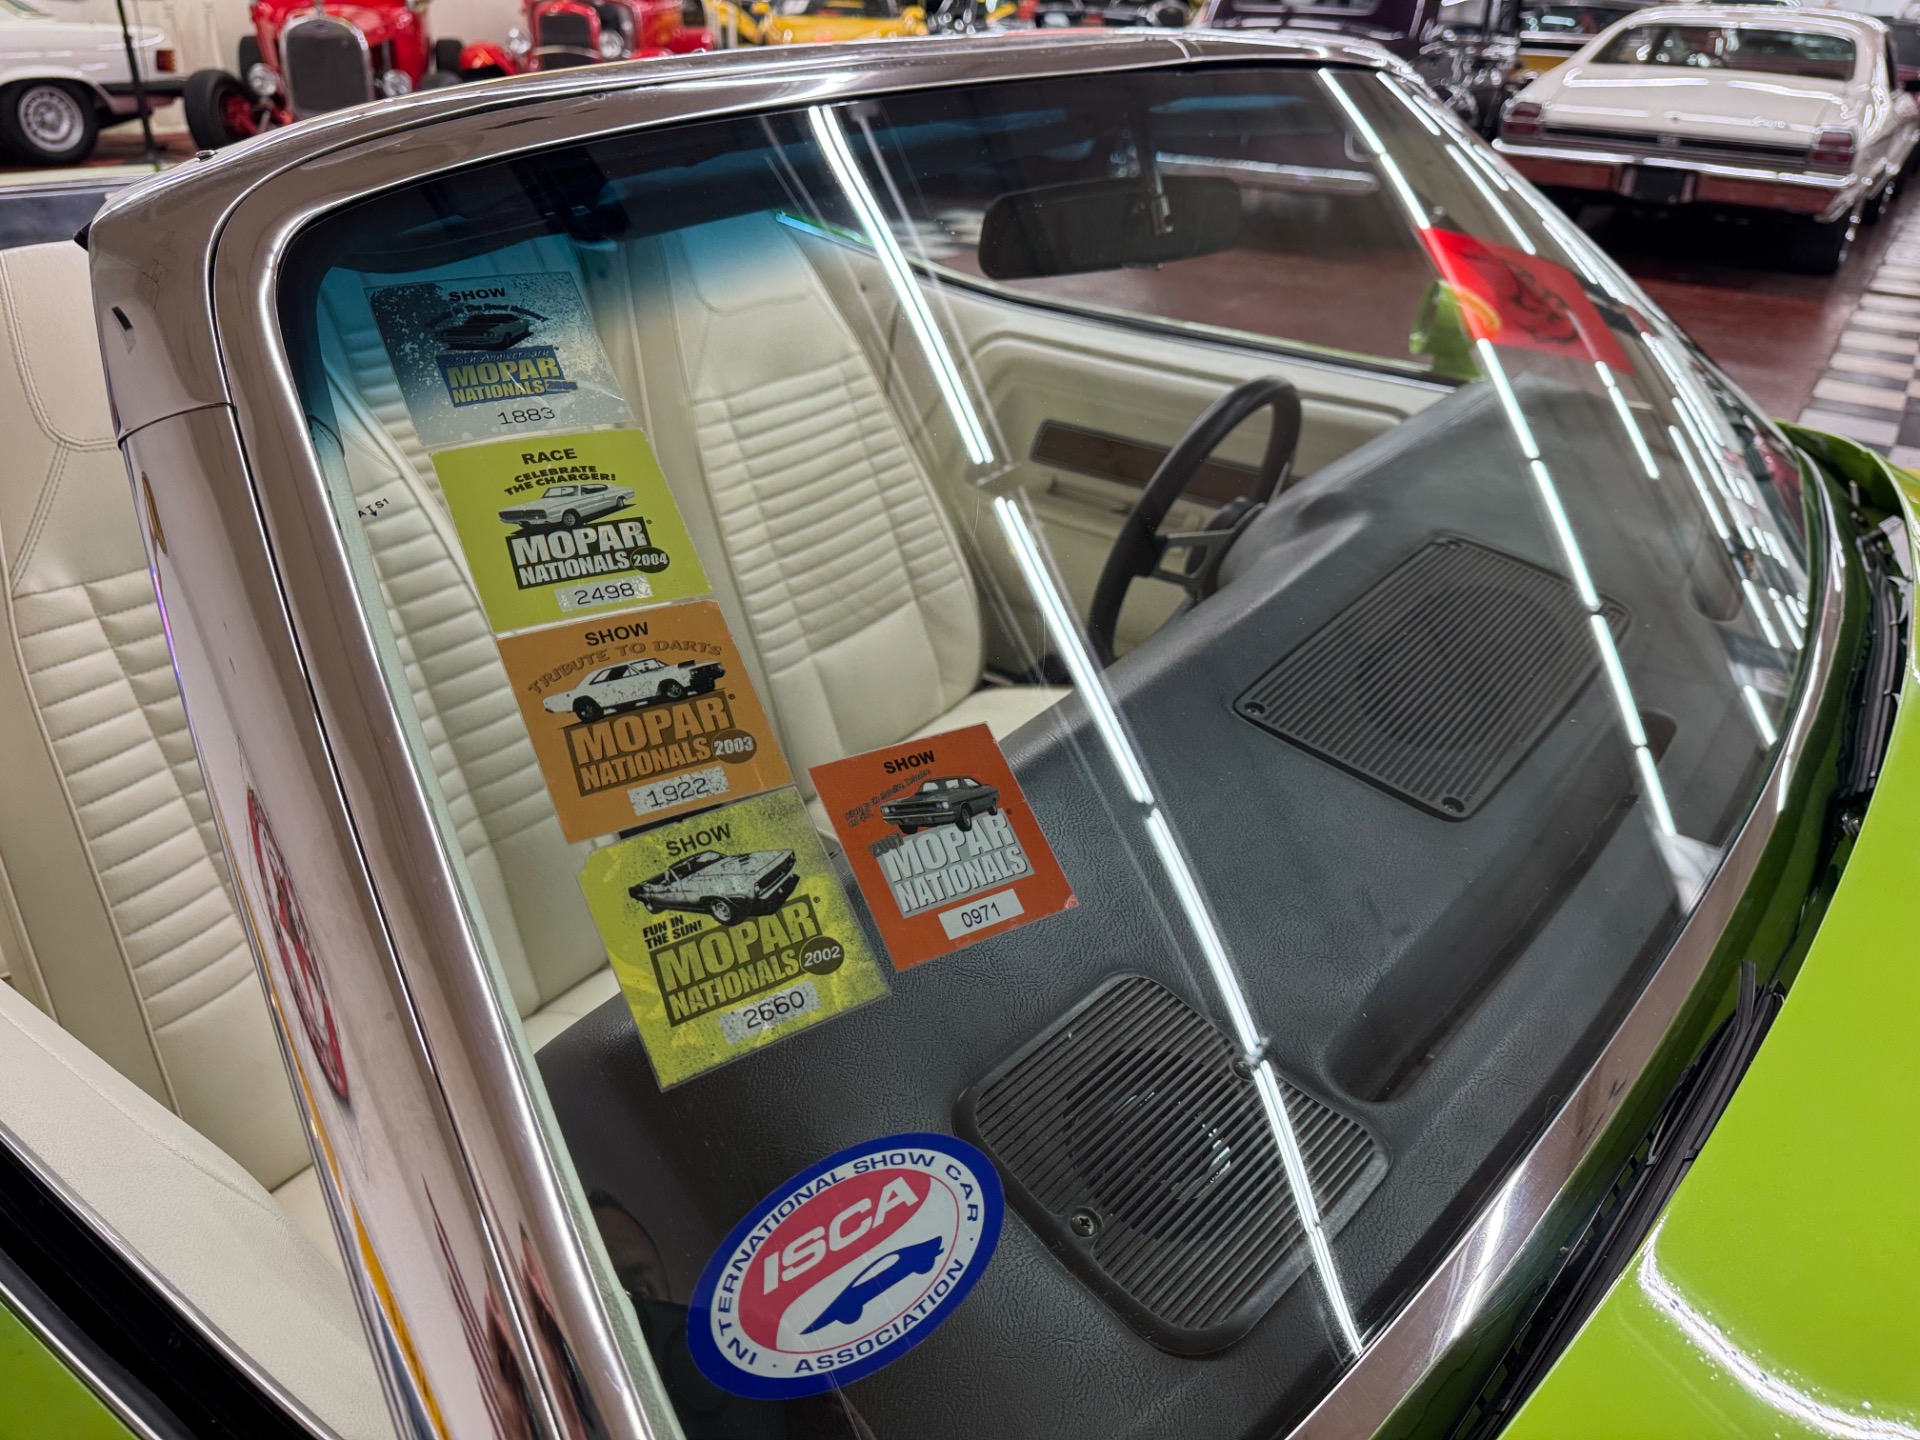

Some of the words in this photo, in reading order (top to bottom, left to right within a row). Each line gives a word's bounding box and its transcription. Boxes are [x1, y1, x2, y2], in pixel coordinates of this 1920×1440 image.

[448, 288, 506, 301] SHOW
[480, 350, 550, 363] Anniversary
[446, 357, 560, 389] MOPAR
[453, 380, 546, 404] NATIONALS
[497, 407, 556, 425] 1883
[521, 448, 578, 465] RACE
[504, 481, 533, 496] THE
[535, 473, 616, 487] CHARGER!
[513, 465, 597, 483] CELEBRATE
[511, 520, 648, 566] MOPAR
[518, 551, 630, 586] NATIONALS
[633, 553, 668, 567] 2004
[574, 582, 635, 605] 2498
[584, 621, 649, 646] SHOW
[527, 649, 611, 695] TRIBUTE
[614, 642, 647, 657] TO
[653, 640, 723, 657] DARTS
[571, 697, 731, 765] MOPAR
[579, 738, 712, 791] NATIONALS
[714, 736, 753, 756] 2003
[883, 750, 936, 775] SHOW
[647, 778, 710, 808] 1922
[666, 823, 732, 858] SHOW
[884, 813, 1015, 883] MOPAR
[894, 846, 1028, 913] NATIONALS
[642, 920, 668, 938] FUN
[670, 914, 685, 927] IN
[961, 902, 1001, 928] 0971
[644, 932, 670, 950] THE
[672, 920, 703, 940] SUN!
[656, 902, 818, 993] MOPAR
[667, 949, 800, 1021] NATIONALS
[803, 946, 842, 968] 2002
[743, 990, 806, 1030] 2660
[763, 1176, 920, 1296] ISCA
[718, 1172, 847, 1366] INTERNATIONAL
[852, 1151, 936, 1175] SHOW
[944, 1164, 979, 1223] CAR
[794, 1258, 965, 1375] ASSOCIATION
